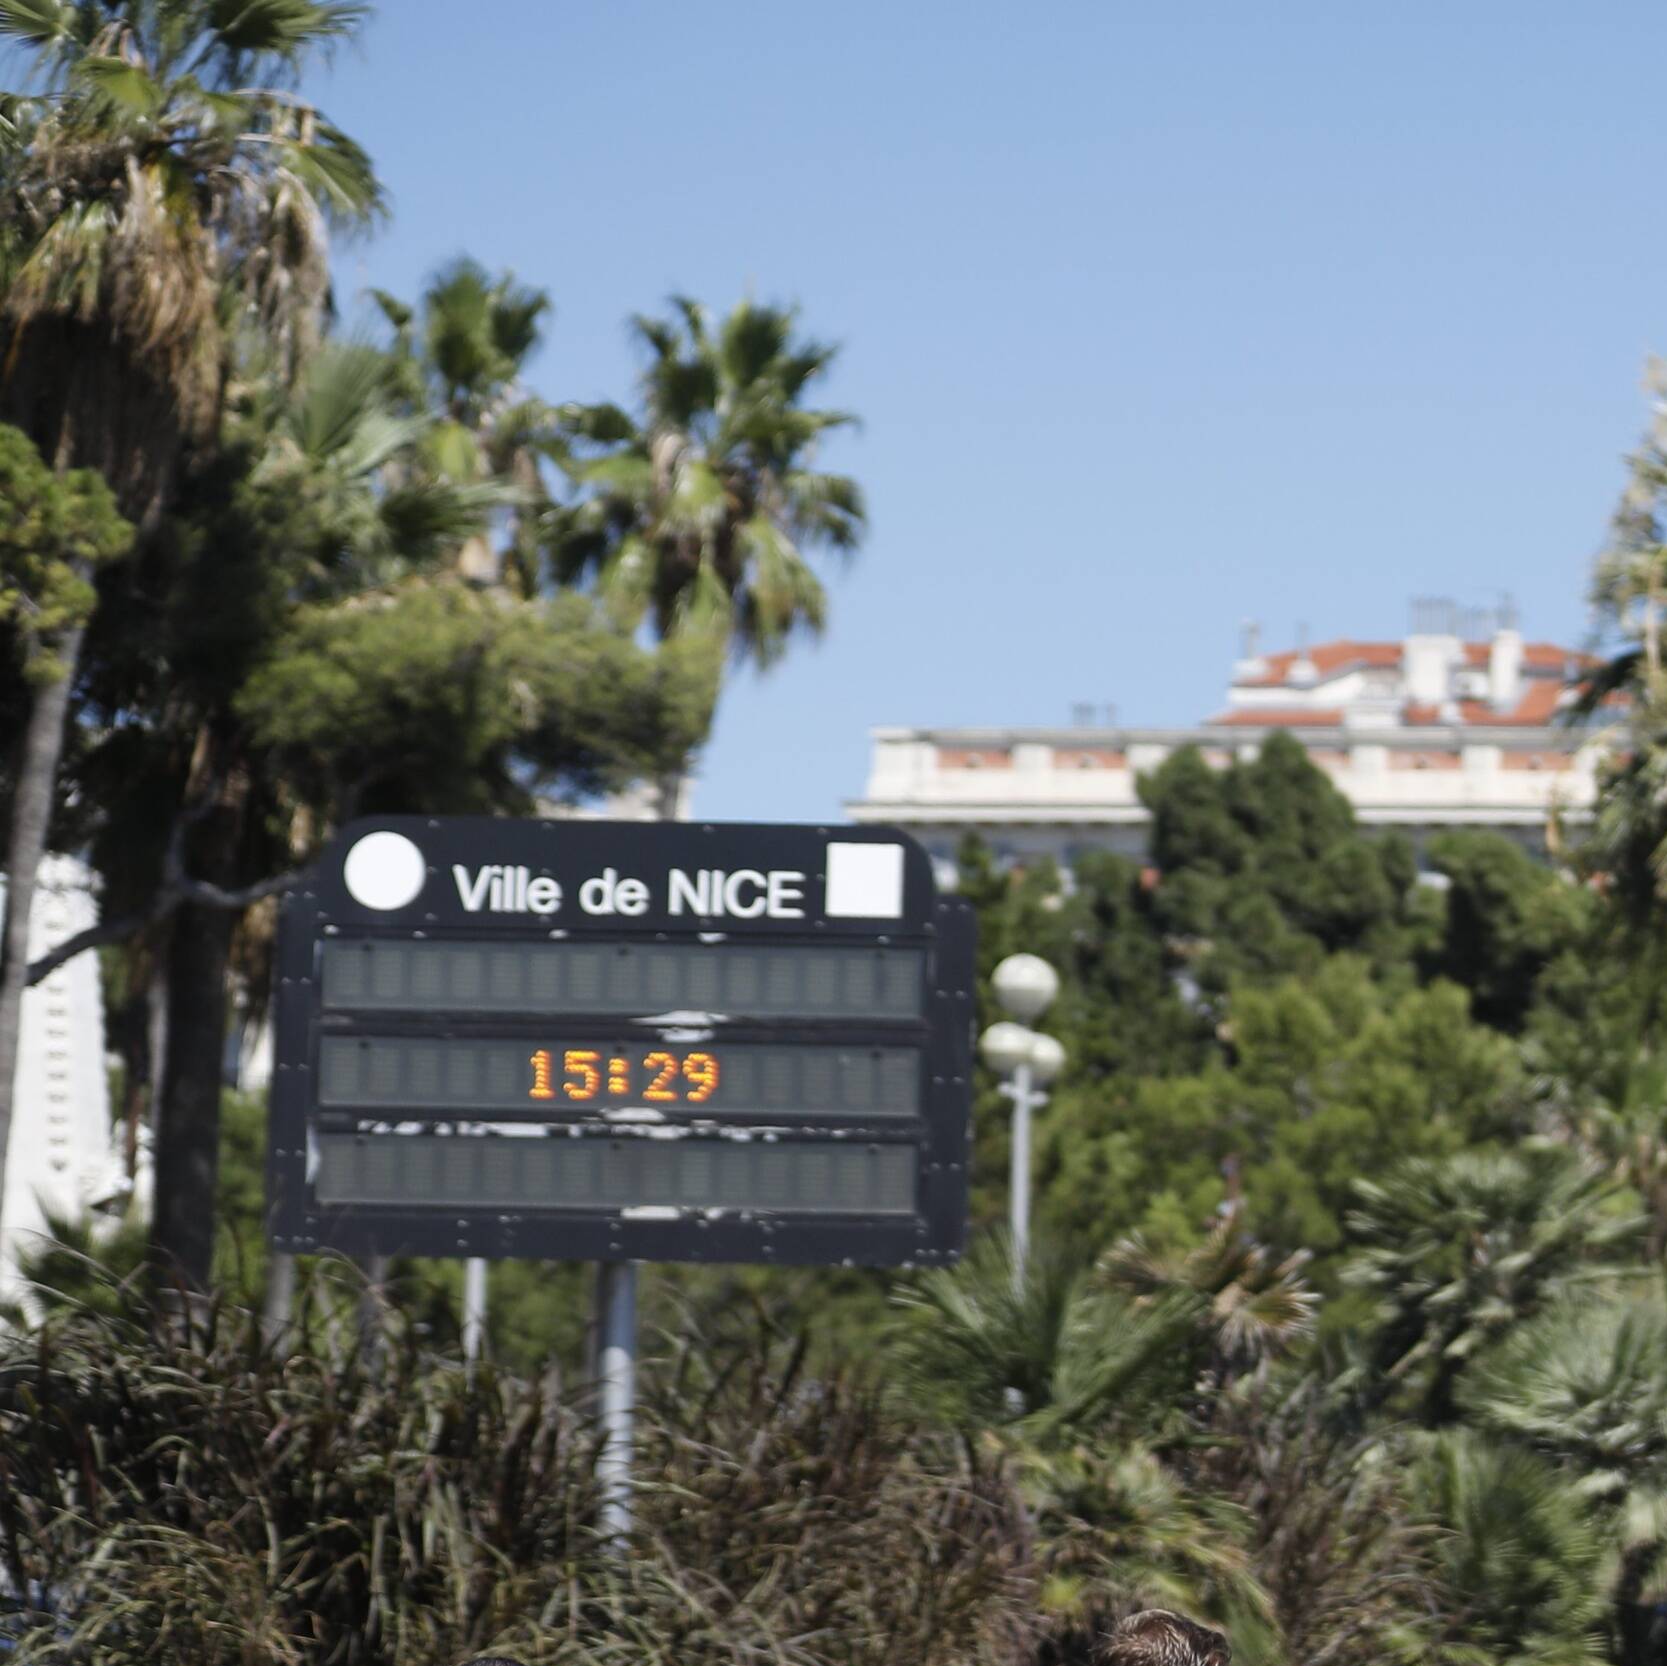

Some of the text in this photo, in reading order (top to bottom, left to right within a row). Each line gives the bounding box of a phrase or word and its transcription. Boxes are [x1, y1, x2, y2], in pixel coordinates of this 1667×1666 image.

[452, 863, 807, 919] Ville de NICE
[529, 1049, 720, 1102] 15:29
